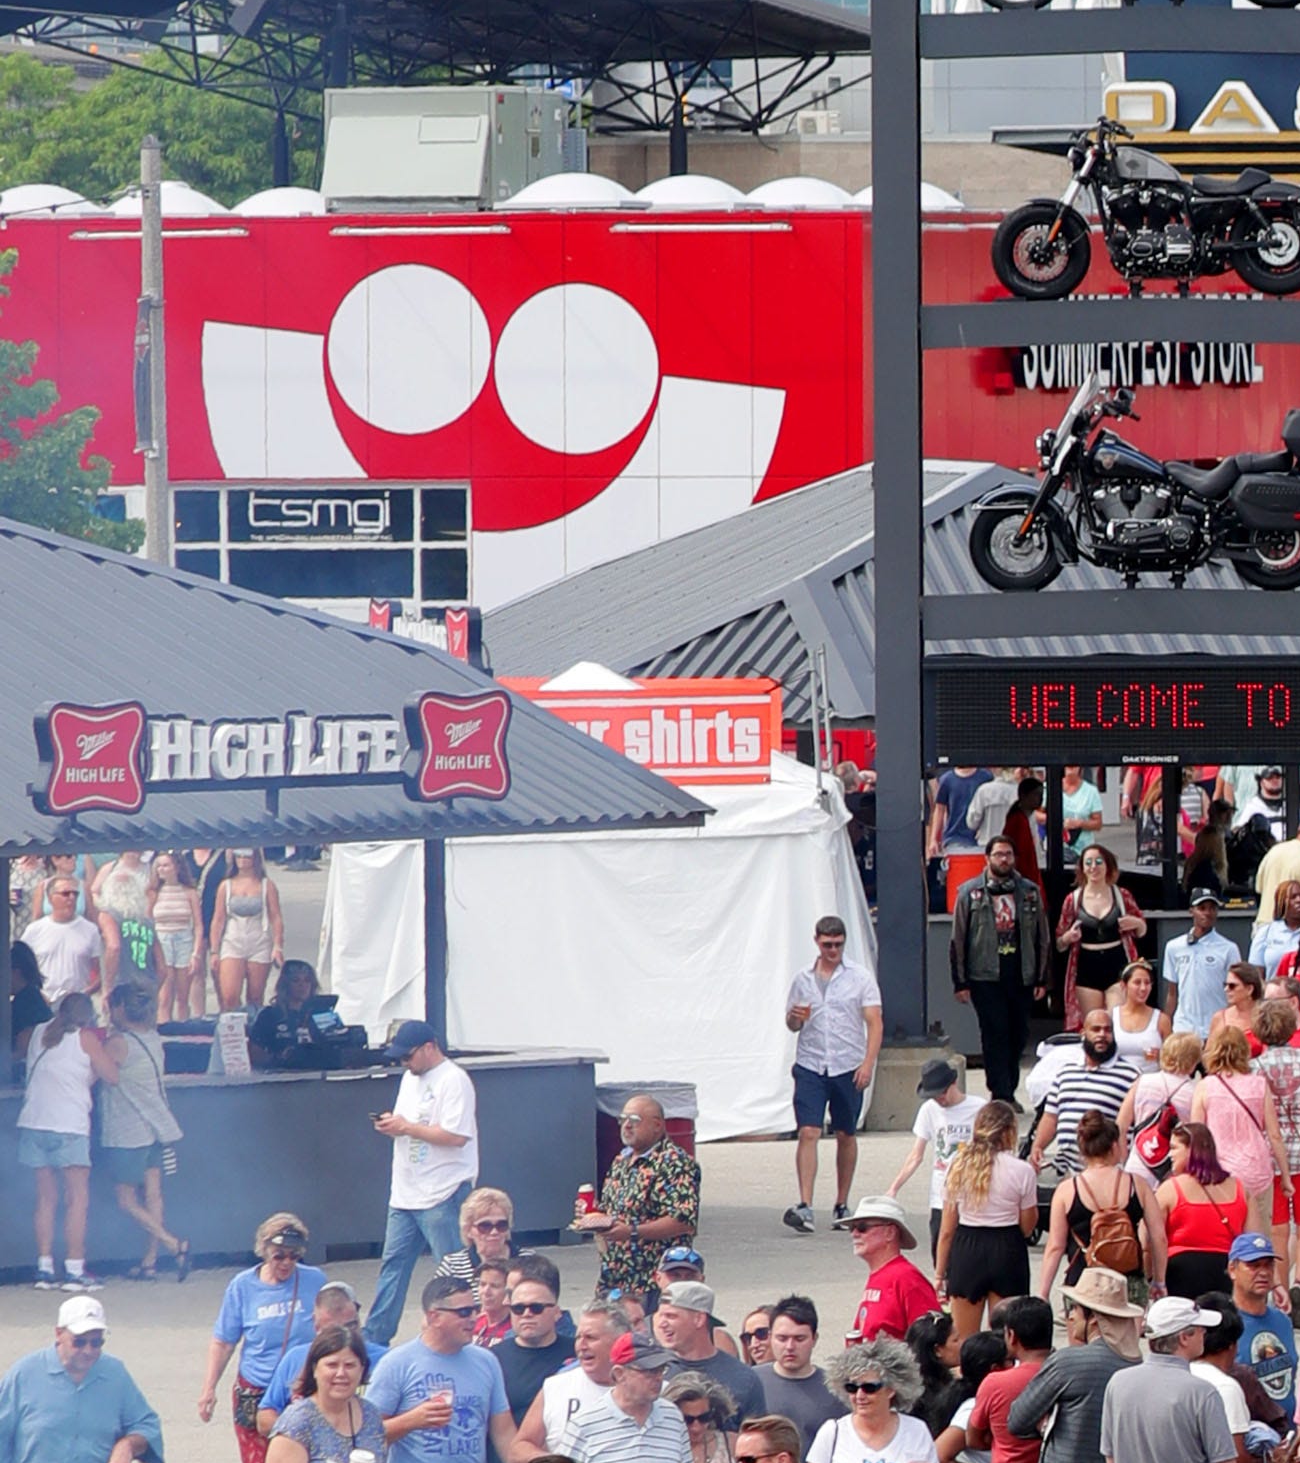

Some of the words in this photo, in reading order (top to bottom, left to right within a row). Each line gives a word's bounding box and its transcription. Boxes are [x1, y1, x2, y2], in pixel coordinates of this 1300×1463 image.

[248, 490, 391, 534] tsmgi
[1009, 683, 1205, 729] WELCOME
[1236, 683, 1292, 729] TO
[76, 731, 117, 761] Miller
[148, 719, 286, 780] HIGH
[289, 715, 401, 776] LIFE
[444, 719, 482, 749] Miller
[623, 708, 761, 764] shirts
[66, 767, 99, 783] HIGH
[100, 765, 126, 781] LIFE
[435, 754, 466, 770] HIGH
[467, 753, 492, 769] LIFE
